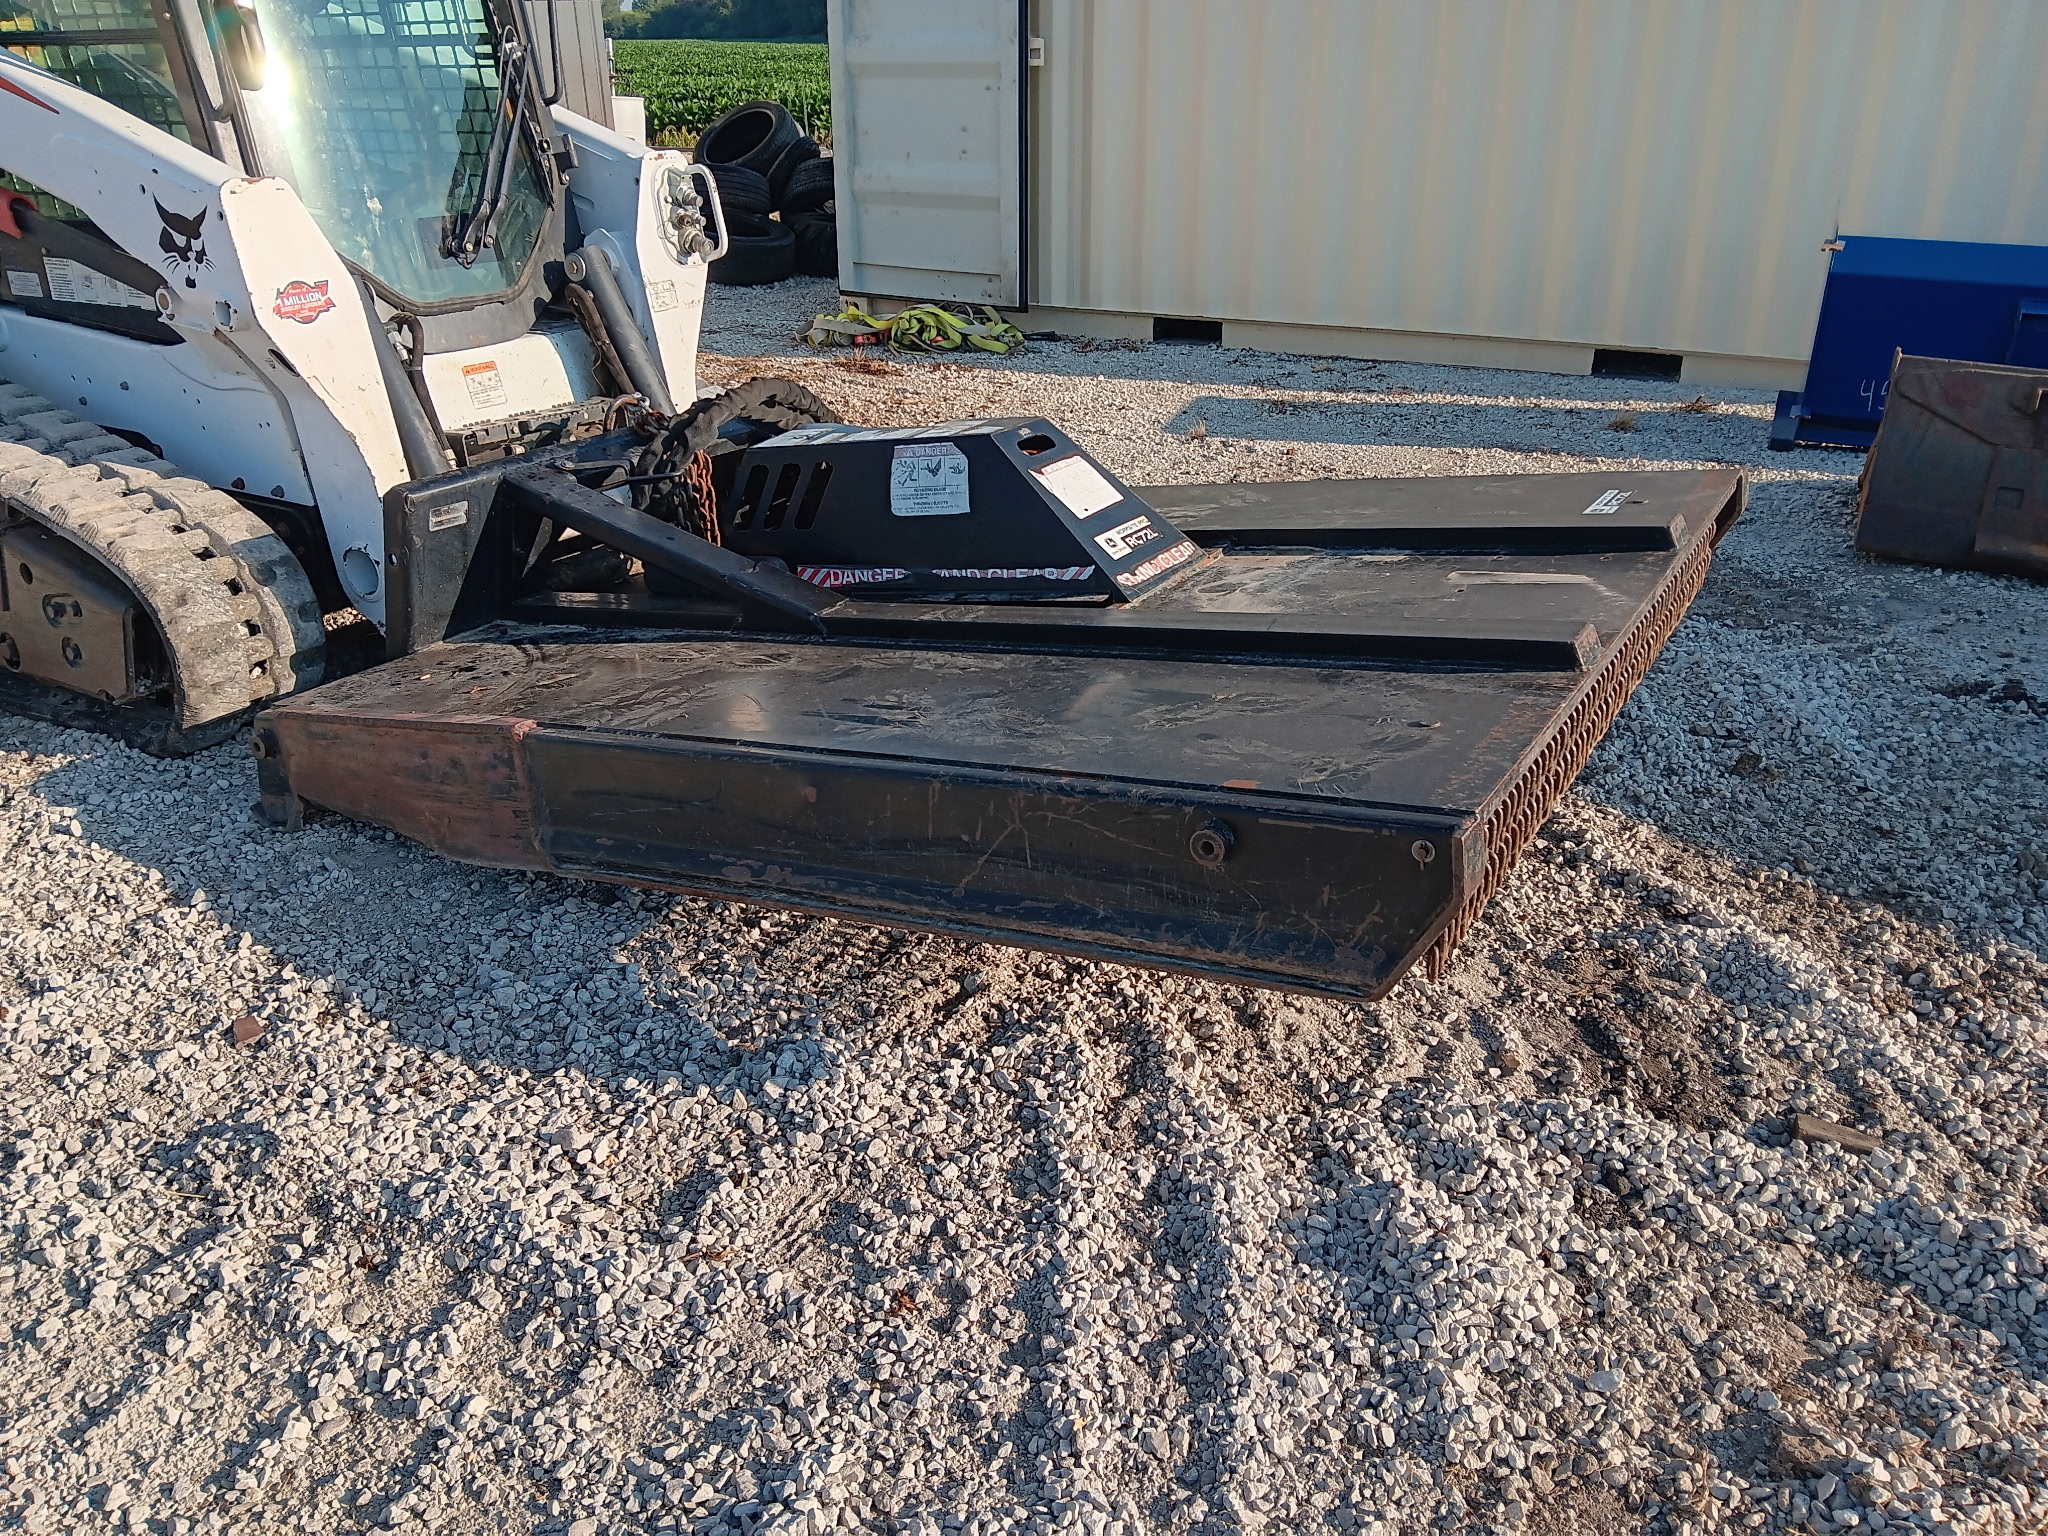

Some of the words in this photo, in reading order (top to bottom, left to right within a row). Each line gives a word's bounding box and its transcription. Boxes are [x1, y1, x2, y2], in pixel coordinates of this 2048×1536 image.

[283, 291, 322, 306] MILLION
[915, 447, 948, 457] DANGER
[1125, 529, 1159, 548] RC72L
[1159, 541, 1196, 569] CLEAR
